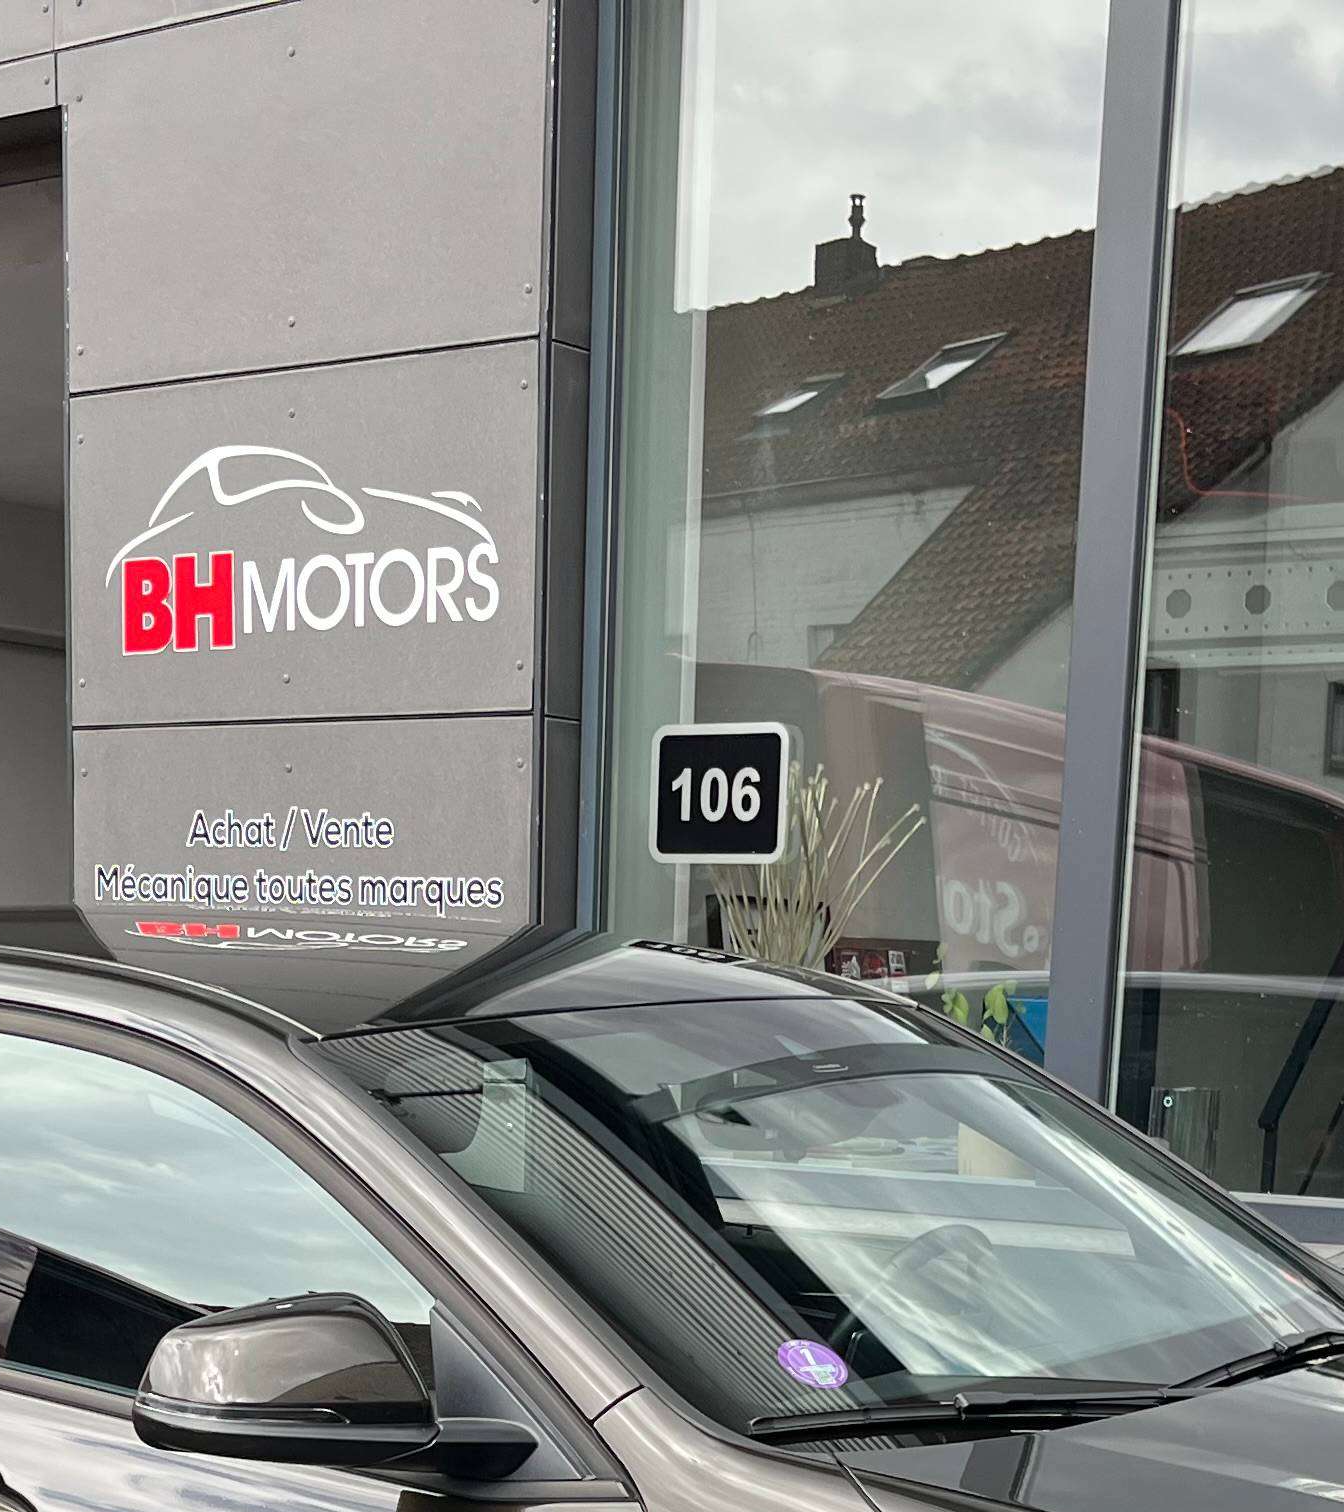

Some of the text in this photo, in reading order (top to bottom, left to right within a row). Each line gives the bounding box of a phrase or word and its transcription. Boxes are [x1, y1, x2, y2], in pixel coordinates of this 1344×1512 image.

[121, 543, 500, 656] BH MOTORS
[670, 767, 762, 822] 106
[186, 806, 394, 851] Achat / Vente
[94, 863, 504, 916] Mécanique toutes marques
